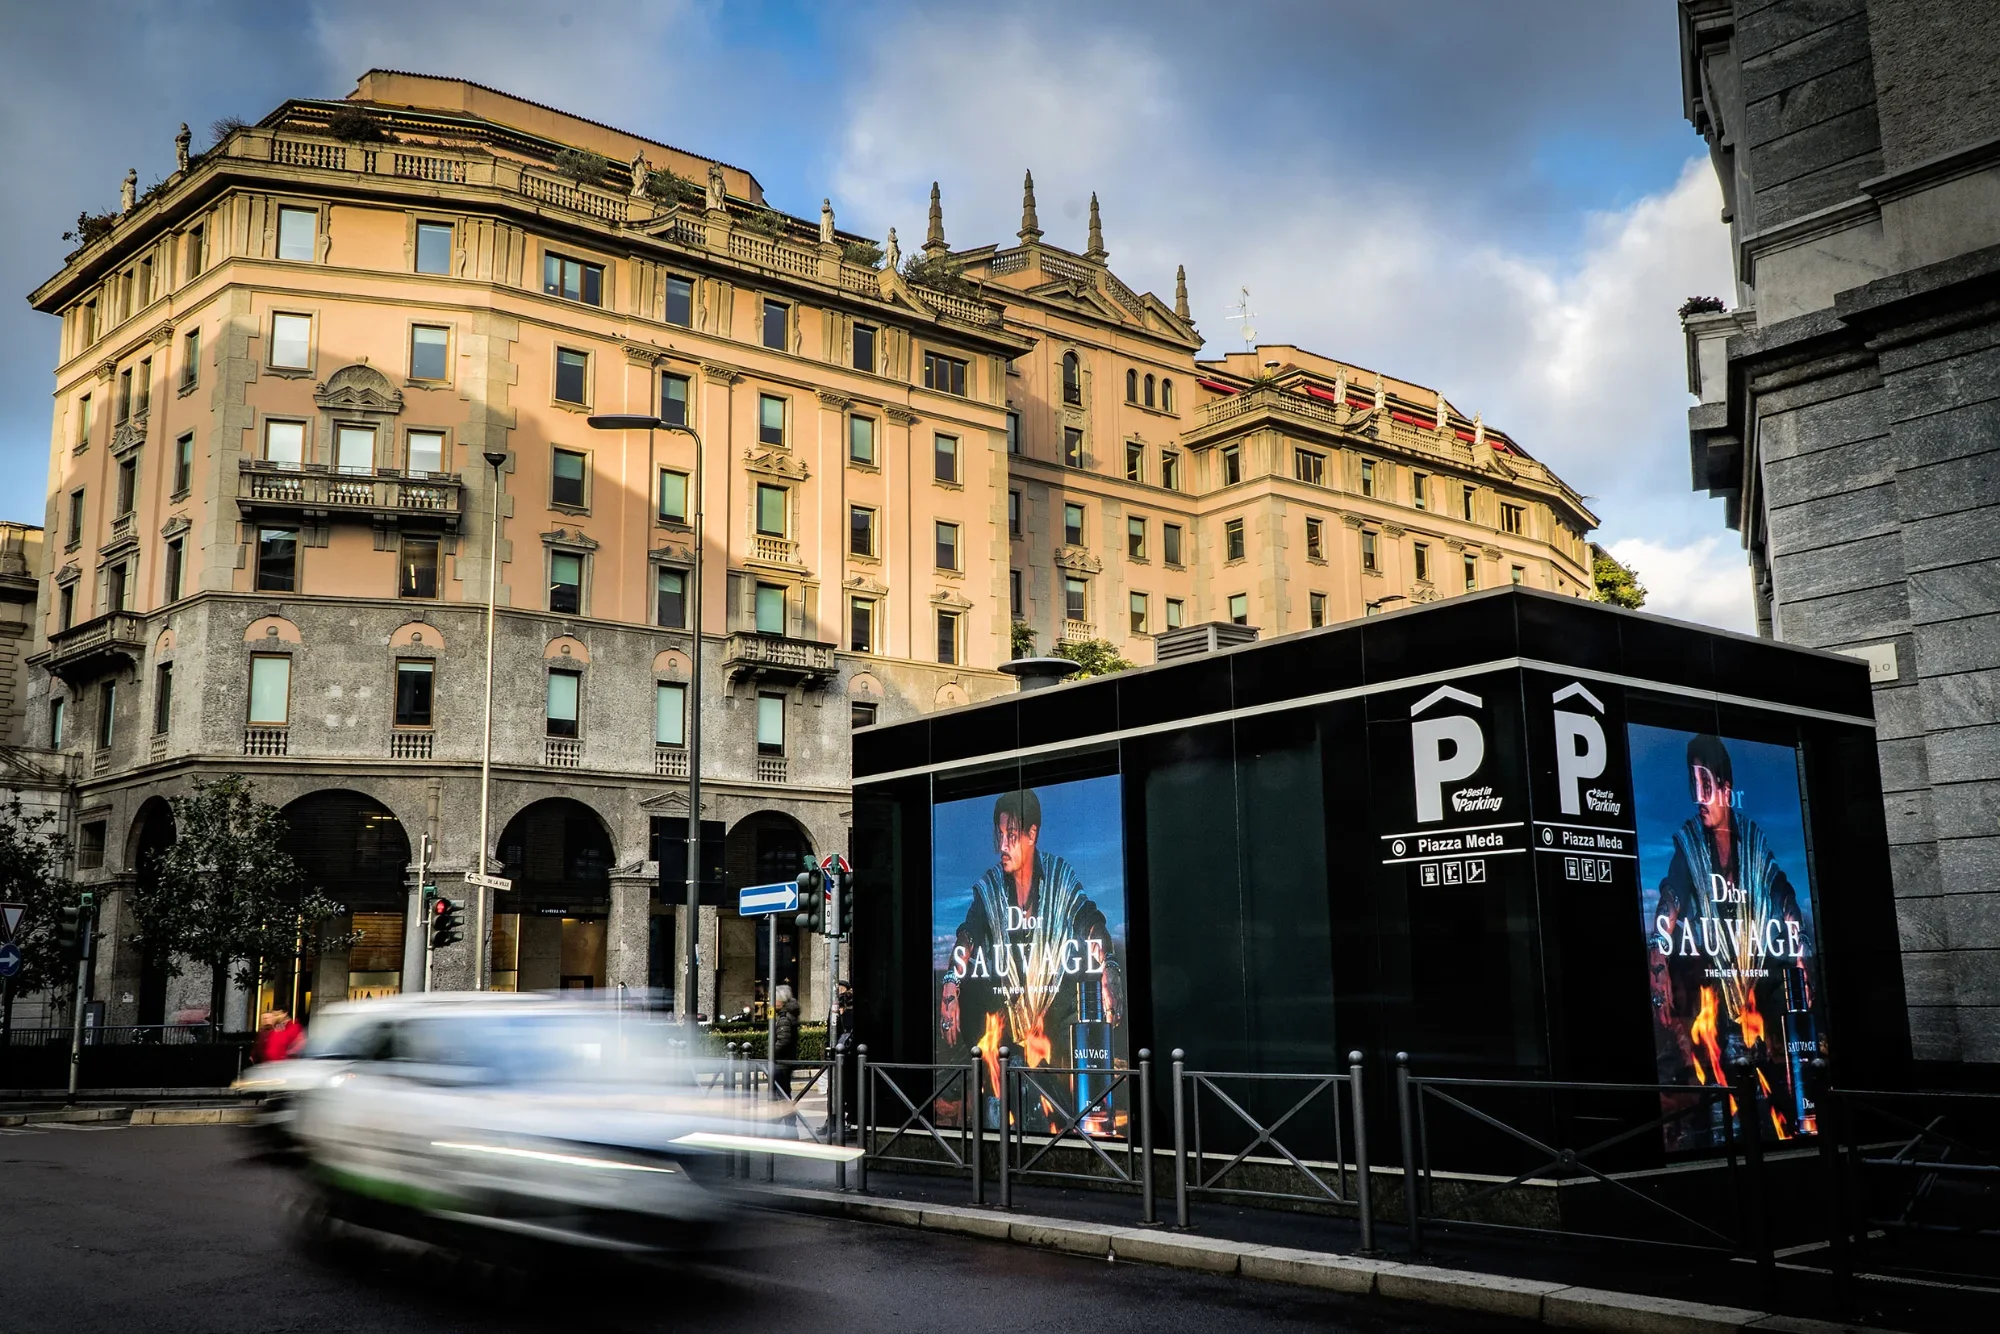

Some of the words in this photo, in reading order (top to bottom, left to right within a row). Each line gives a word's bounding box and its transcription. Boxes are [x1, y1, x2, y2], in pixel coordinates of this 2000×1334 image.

[1412, 715, 1484, 823] P
[1554, 710, 1607, 815] P
[1466, 787, 1484, 797] Best
[1484, 786, 1493, 796] in
[1595, 789, 1608, 798] Best
[1608, 790, 1614, 799] in
[1457, 796, 1503, 812] Parking
[1590, 798, 1621, 816] Parking
[1418, 838, 1462, 853] Piazza
[1465, 832, 1504, 848] Meda
[1562, 831, 1595, 847] Piazza
[1597, 834, 1623, 849] Meda
[1709, 873, 1748, 904] Dior
[1005, 906, 1044, 931] Dior
[1656, 914, 1804, 958] SAUVAGE
[953, 939, 1105, 979] SAUVAGE
[1704, 968, 1719, 977] THE
[1721, 968, 1738, 978] NEW
[1740, 968, 1769, 978] PARFUM
[992, 986, 1007, 995] THE
[1009, 986, 1025, 995] NEW
[1028, 985, 1060, 994] PARFUM
[1074, 1048, 1109, 1060] SAUVAGE
[1787, 1041, 1816, 1053] SAUVAGE
